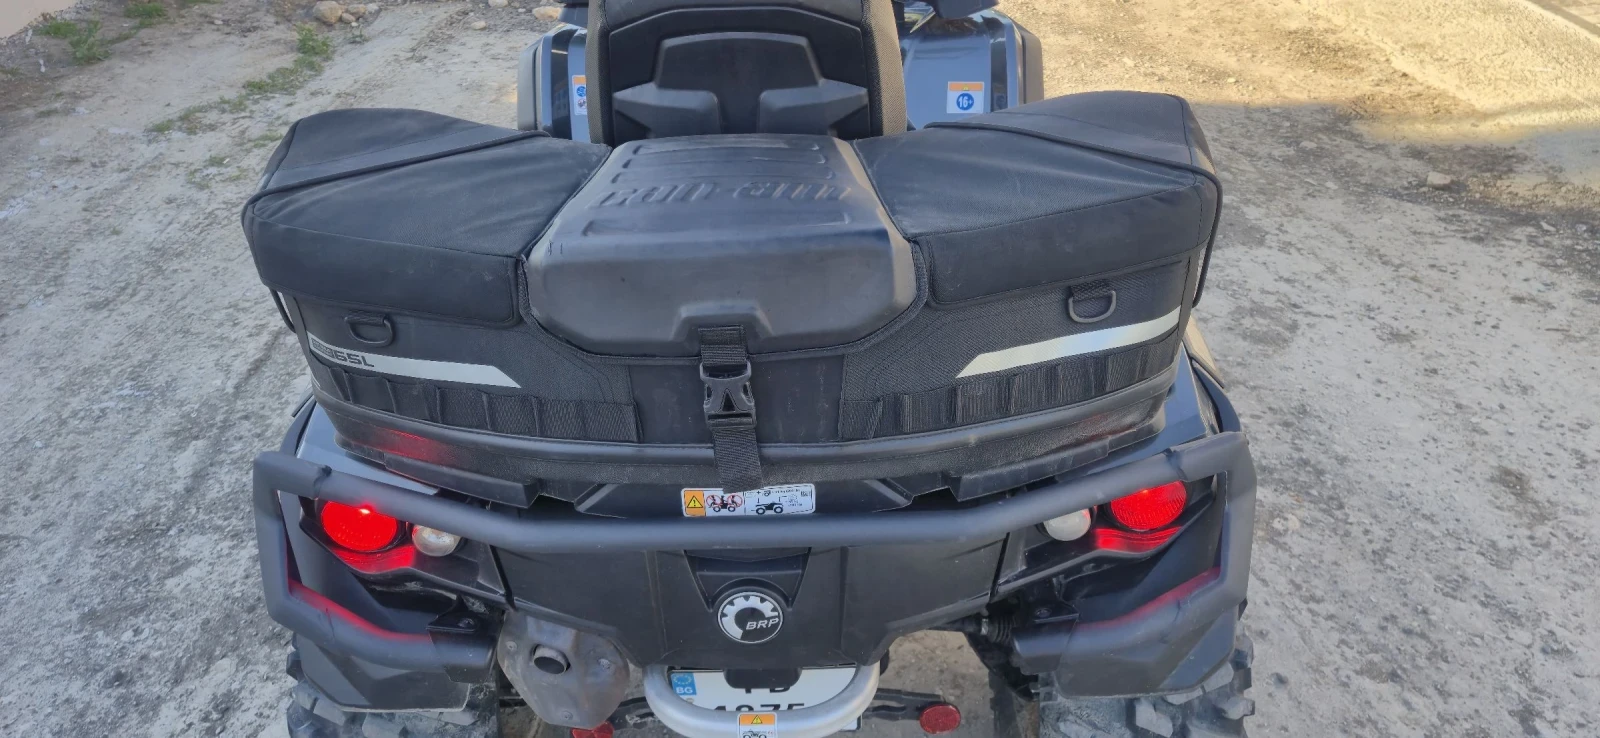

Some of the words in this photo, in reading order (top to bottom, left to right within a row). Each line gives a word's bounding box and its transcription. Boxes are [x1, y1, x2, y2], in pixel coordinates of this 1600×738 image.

[958, 95, 973, 108] 16+
[334, 350, 375, 368] 65L
[745, 617, 780, 631] BRP
